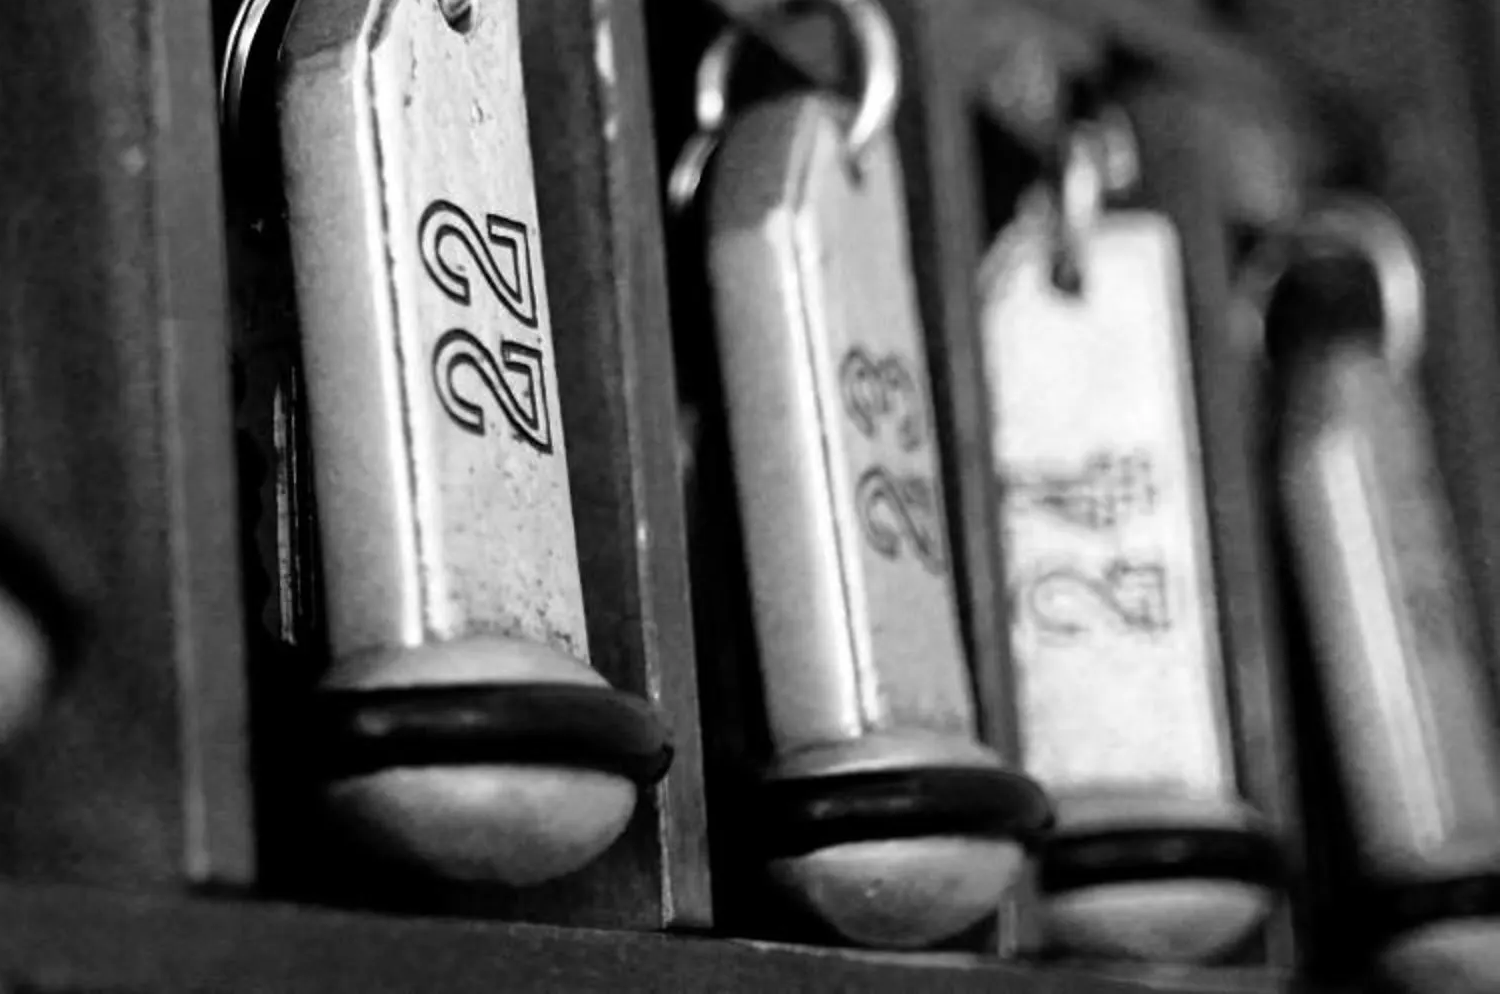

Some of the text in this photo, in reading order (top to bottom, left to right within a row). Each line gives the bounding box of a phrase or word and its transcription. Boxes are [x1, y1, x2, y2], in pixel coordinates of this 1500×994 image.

[417, 198, 554, 456] 22
[837, 344, 950, 578] 23
[1003, 448, 1172, 646] 24
